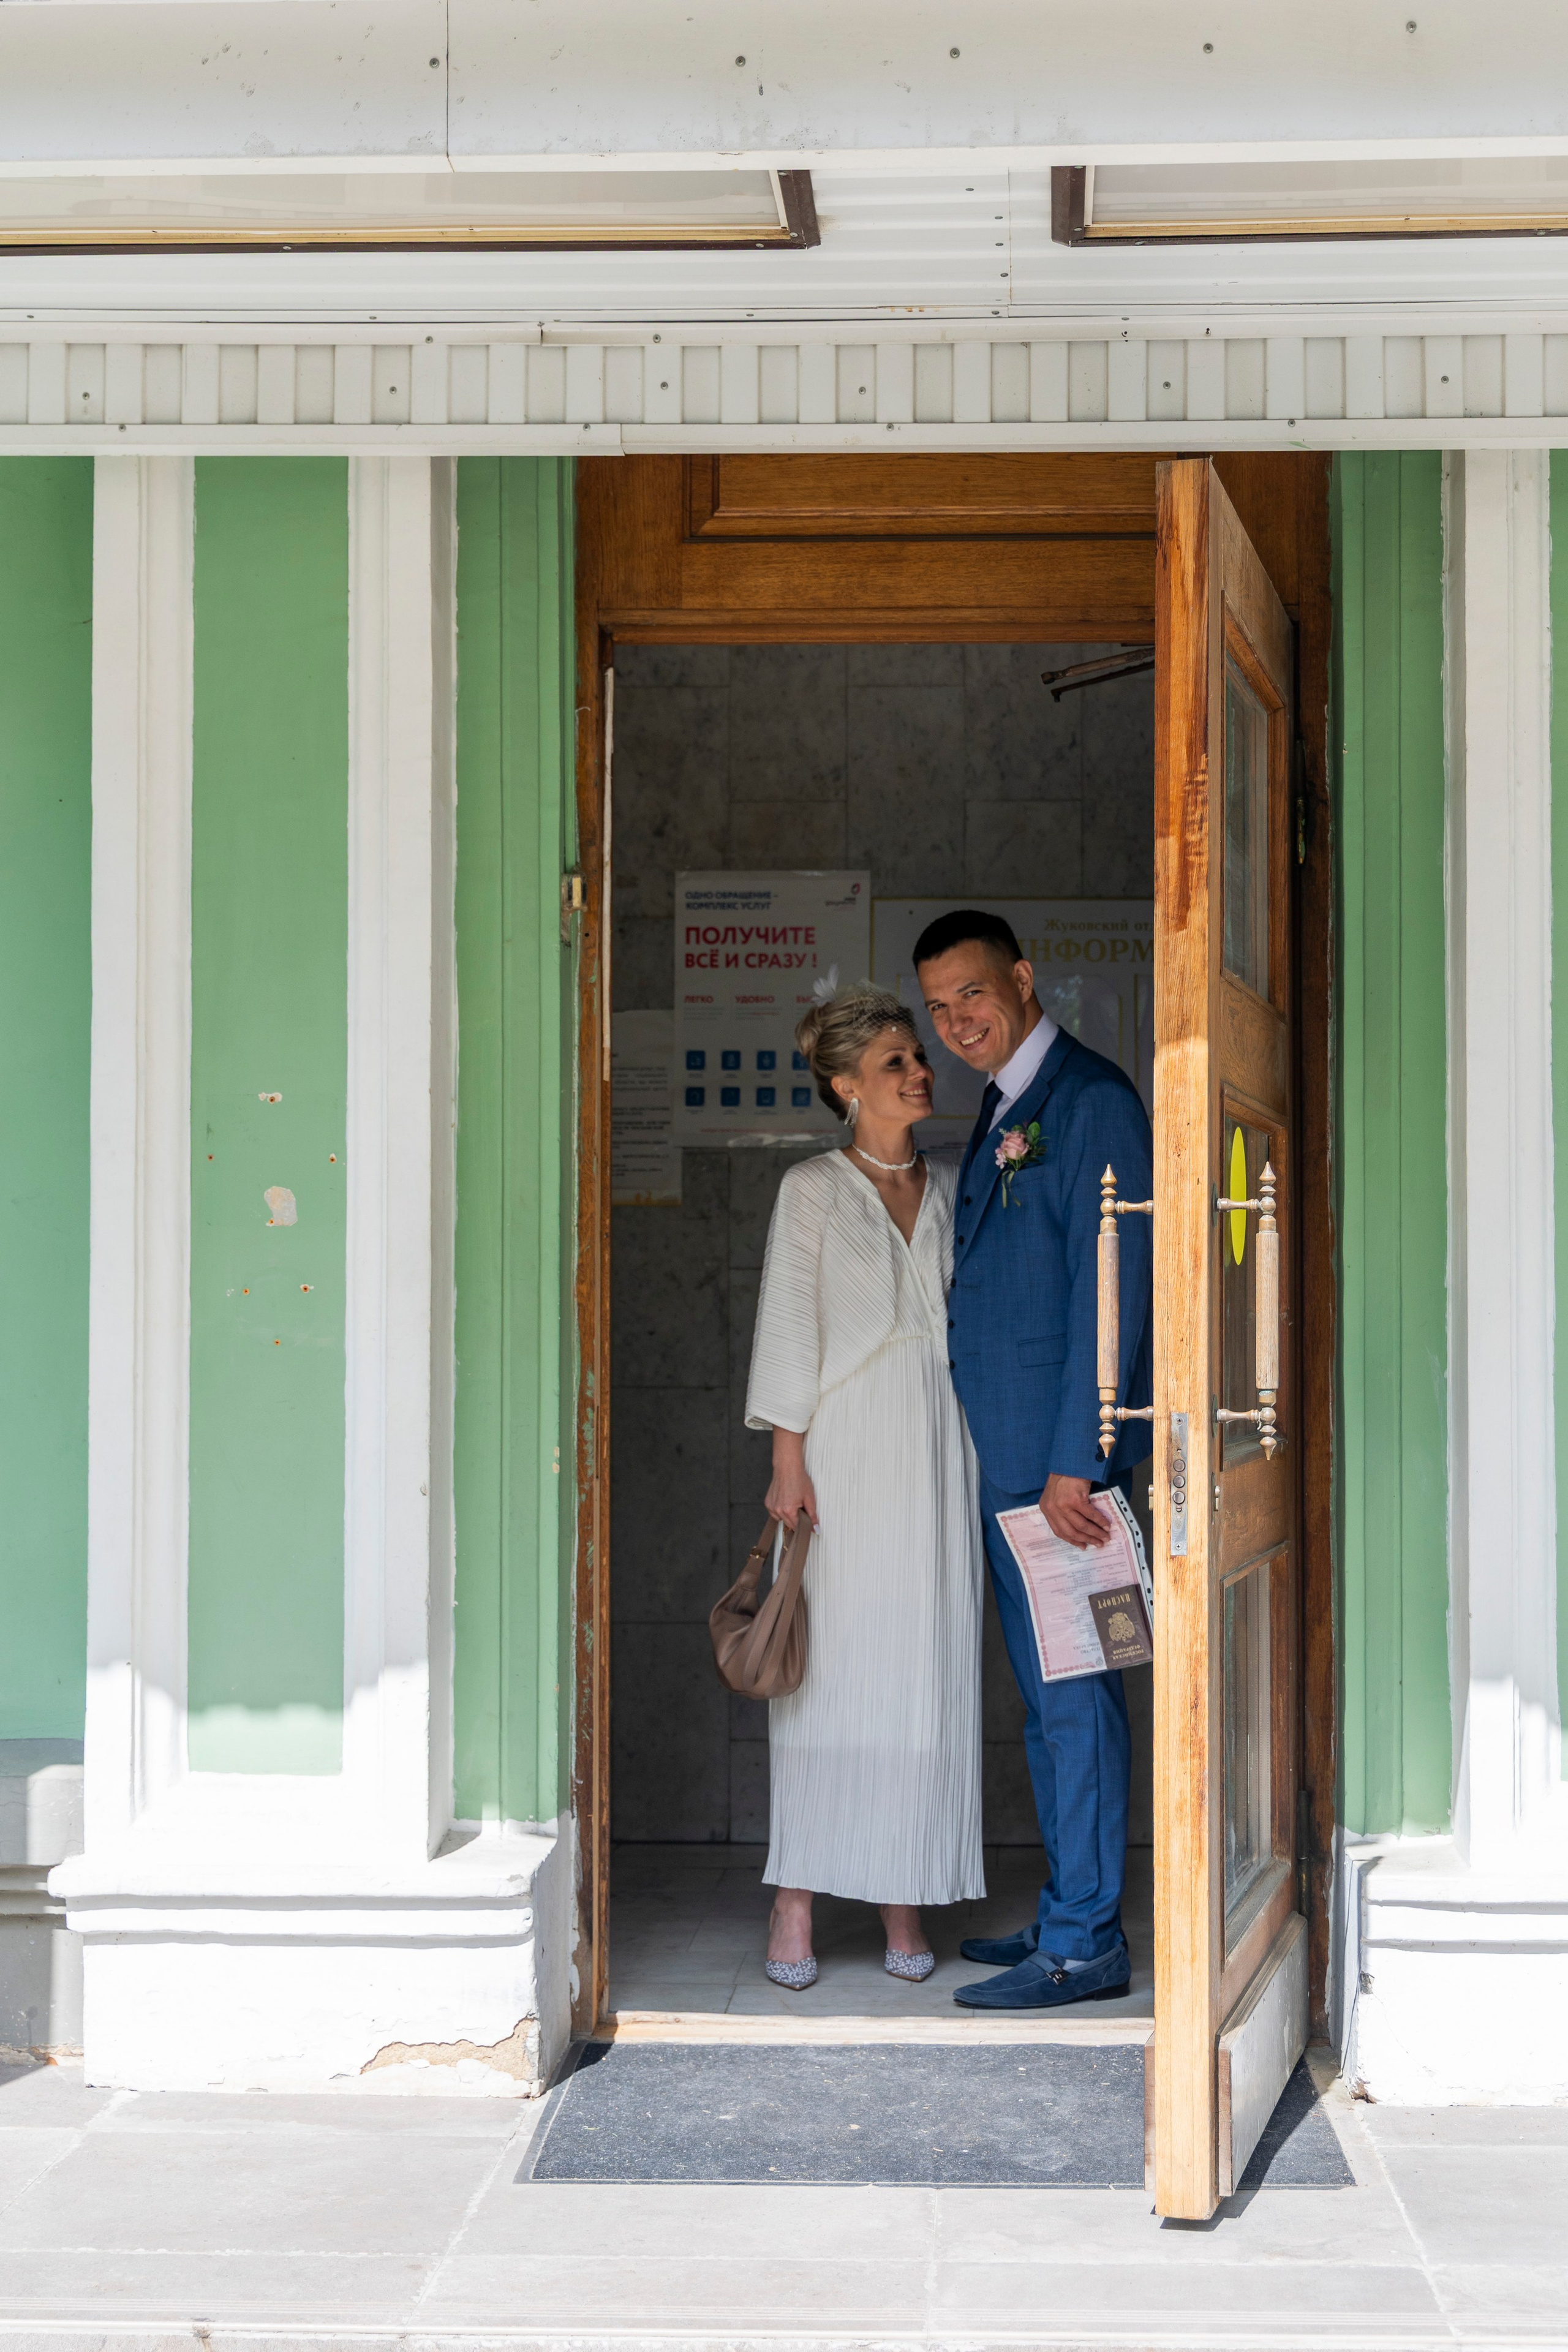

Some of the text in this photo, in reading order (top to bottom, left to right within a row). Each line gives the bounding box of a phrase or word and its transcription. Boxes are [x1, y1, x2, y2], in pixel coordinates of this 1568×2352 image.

[685, 902, 771, 910] КОМПЛЕКС УСЛУГ
[1044, 918, 1128, 934] Жуковский
[685, 927, 816, 944] ПОЛУЧИТЕ
[685, 949, 719, 968] ВСЁ
[725, 952, 739, 968] И
[744, 952, 807, 968] СРАЗУ
[735, 995, 775, 1004] УДОБНО
[1098, 1593, 1131, 1609] ПАСПОРТ
